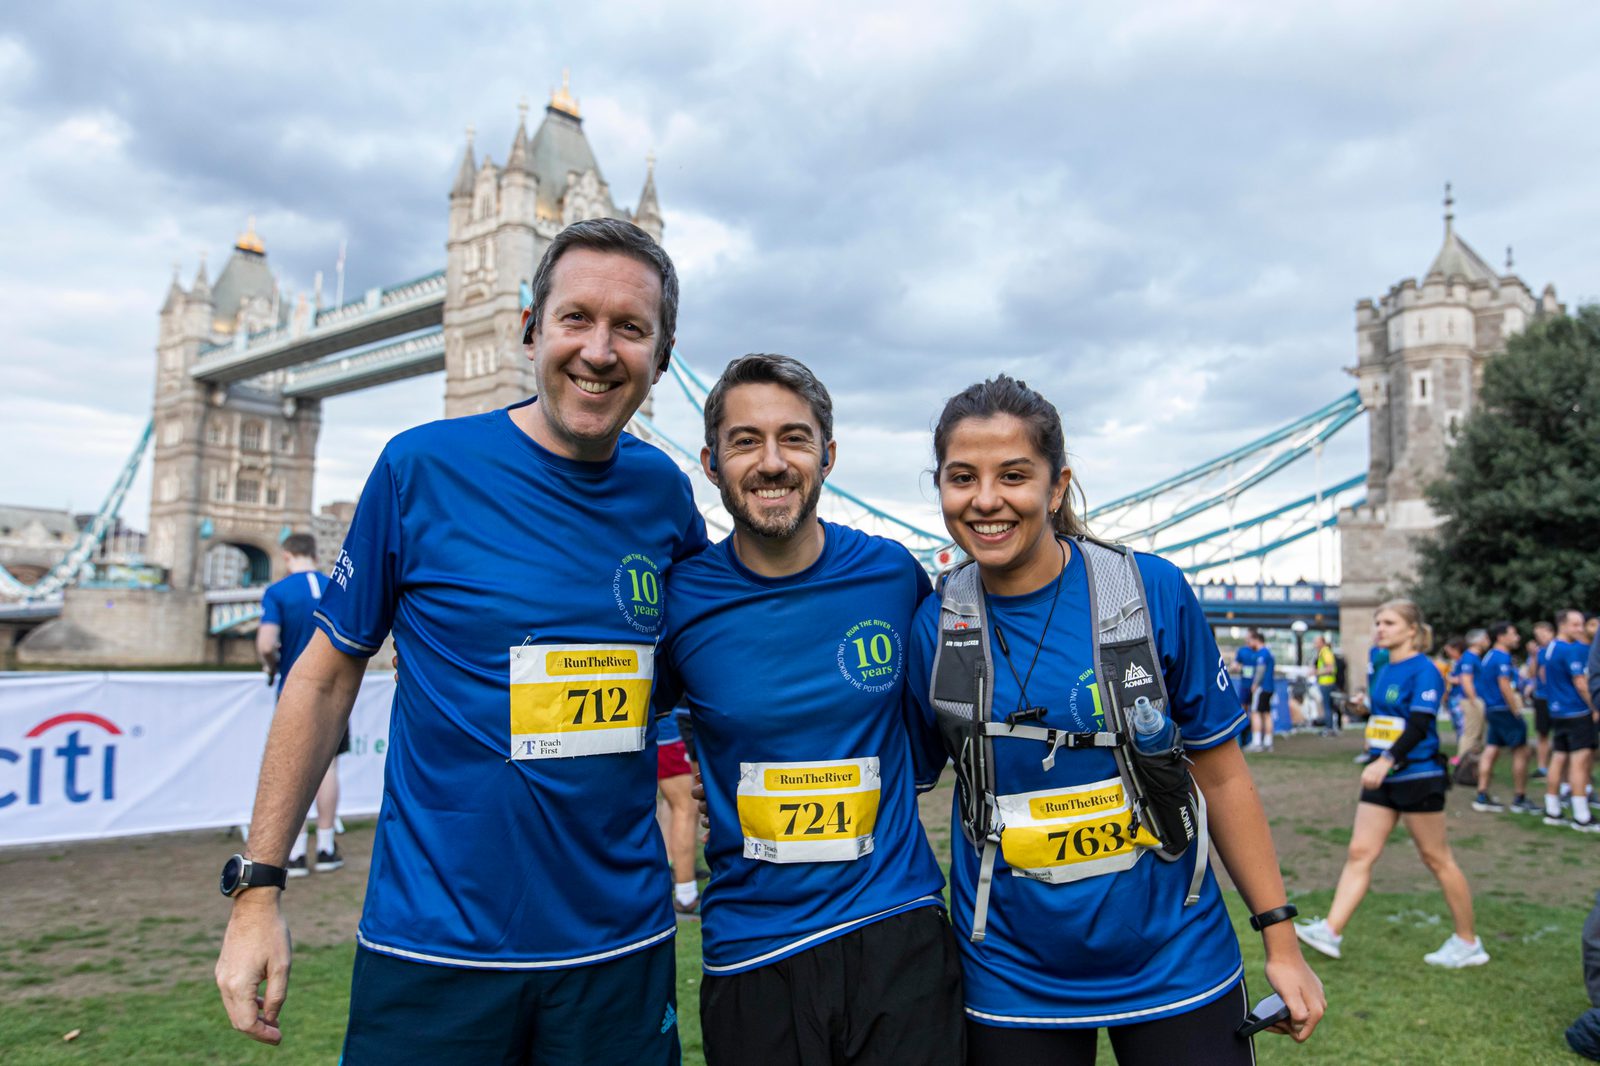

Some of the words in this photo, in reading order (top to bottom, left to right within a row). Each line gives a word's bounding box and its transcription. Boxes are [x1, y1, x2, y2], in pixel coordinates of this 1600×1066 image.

[621, 554, 633, 566] RUN
[631, 553, 643, 561] THE
[612, 568, 626, 611] UNLOCKING
[622, 610, 634, 625] THE
[627, 569, 658, 605] 10
[633, 605, 659, 617] years
[845, 624, 860, 638] RUN
[858, 619, 873, 628] THE
[873, 619, 891, 630] RIVER
[852, 633, 893, 669] 10
[557, 656, 632, 669] #RunTheRiver
[837, 643, 852, 681] UNLOCKING
[850, 678, 863, 690] THE
[862, 680, 896, 693] POTENTIAL
[861, 665, 893, 682] years
[1078, 667, 1094, 682] RUN
[1124, 676, 1153, 689] AONIJIE
[567, 687, 629, 725] 712
[1085, 682, 1104, 717] 1
[539, 739, 561, 748] Teach
[540, 747, 558, 755] First
[774, 772, 853, 785] #RunTheRiver
[1040, 793, 1120, 813] #RunTheRiver
[779, 801, 852, 836] 724
[1179, 805, 1195, 842] AONIJIE
[1047, 822, 1125, 861] 763
